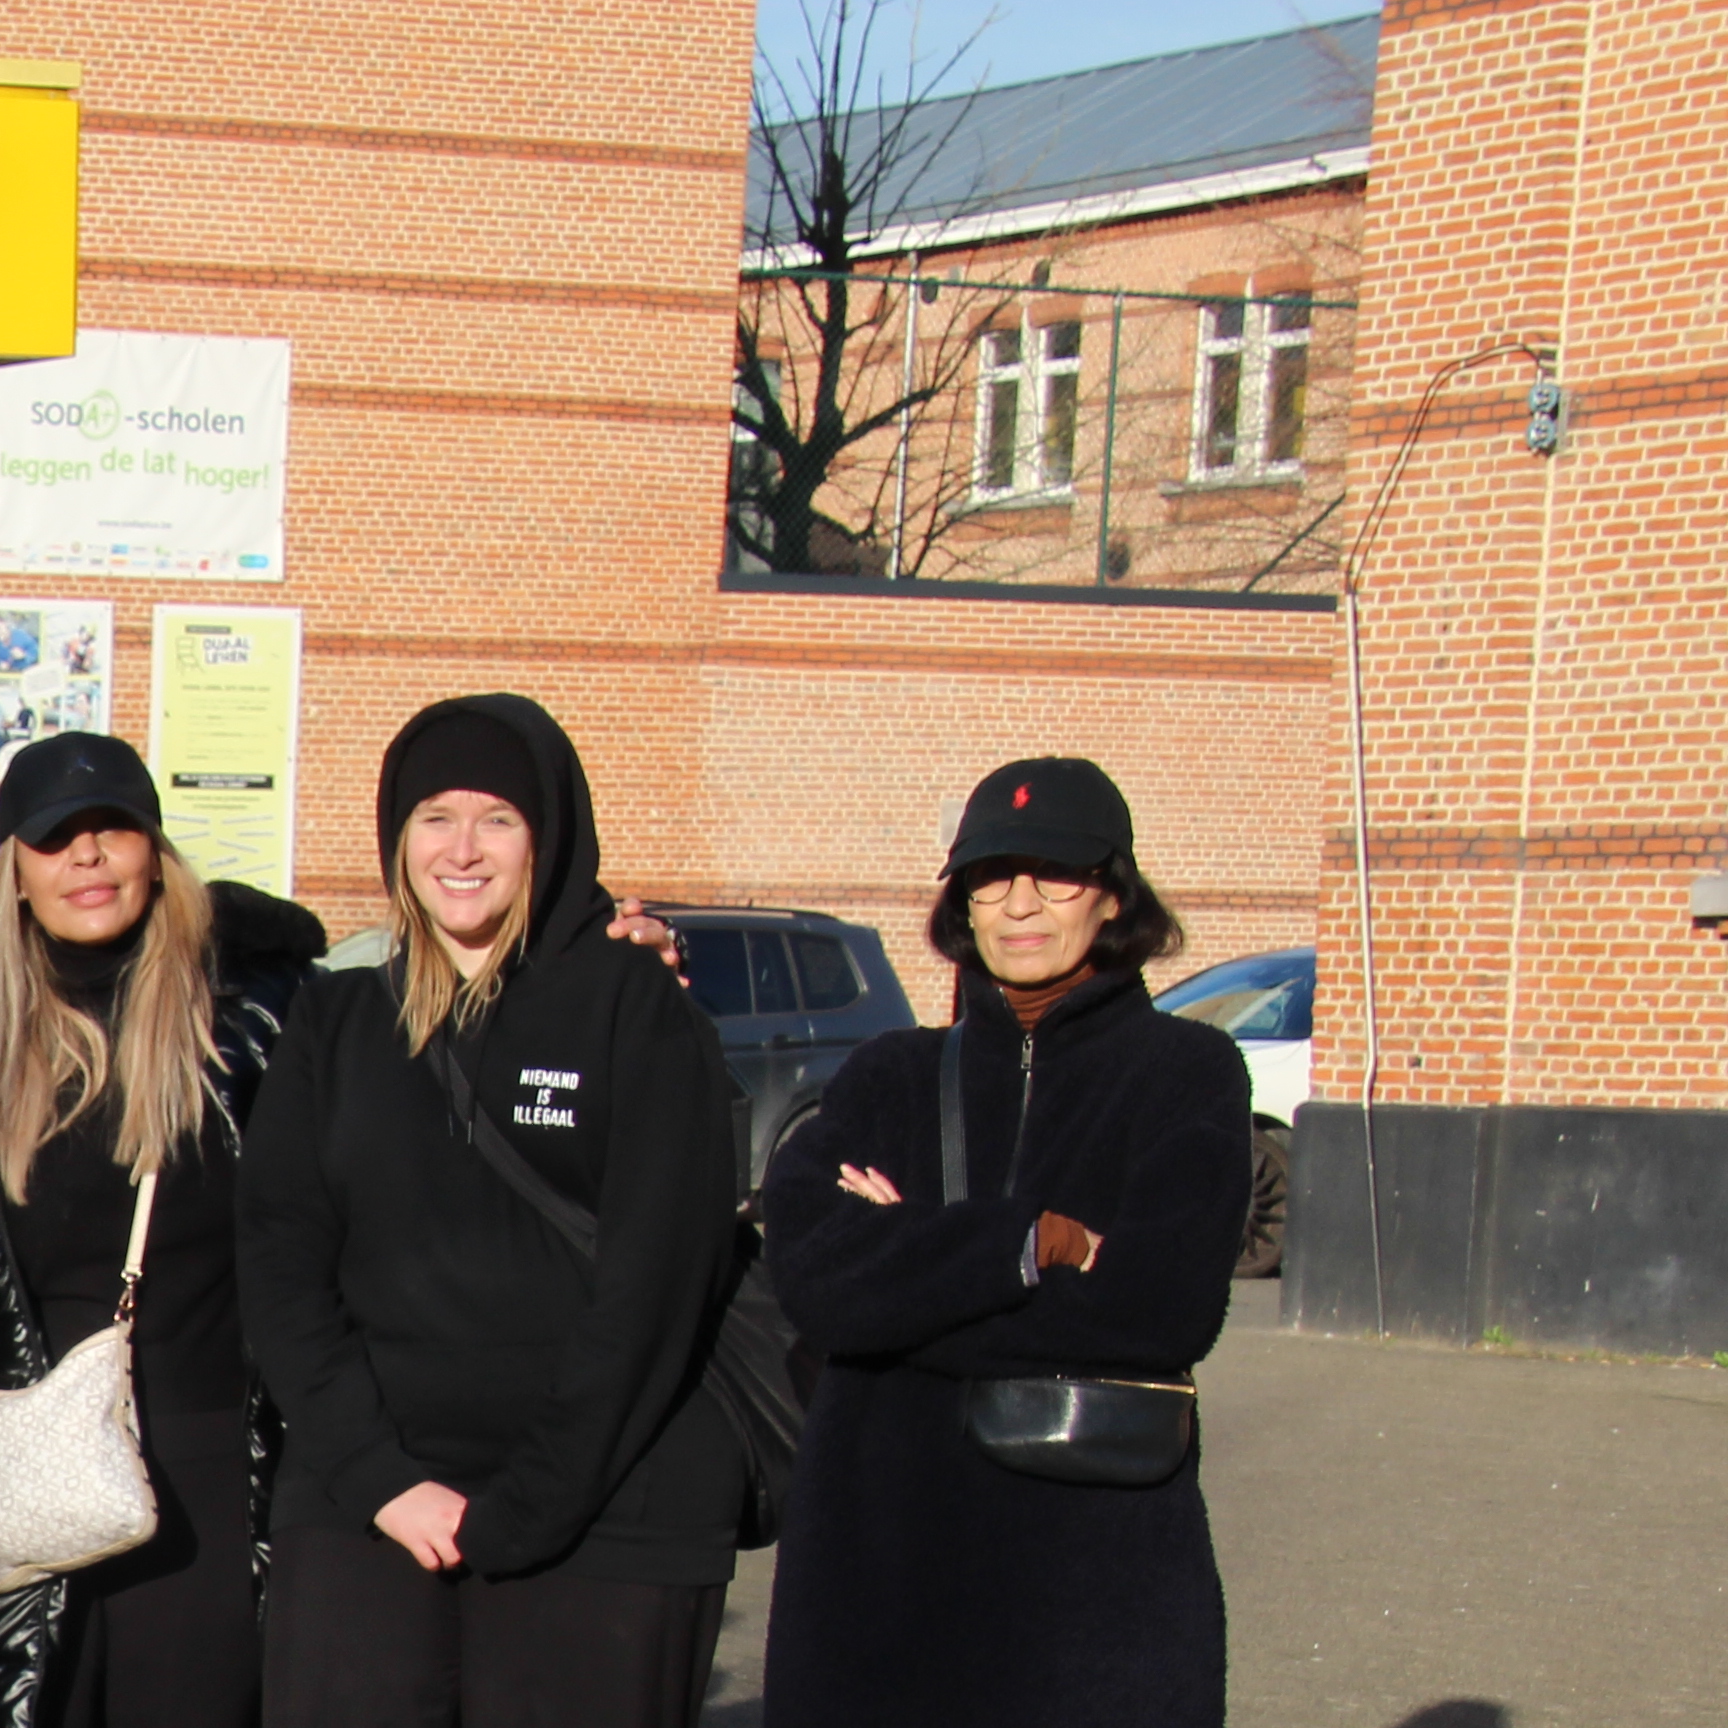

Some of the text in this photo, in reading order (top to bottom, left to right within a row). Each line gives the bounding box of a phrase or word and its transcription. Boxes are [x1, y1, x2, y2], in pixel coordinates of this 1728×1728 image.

[0, 446, 270, 494] leggen de lat hoger!
[519, 1068, 580, 1090] NIEMAND
[536, 1088, 552, 1105] IS
[513, 1105, 576, 1128] ILLEGAAL
